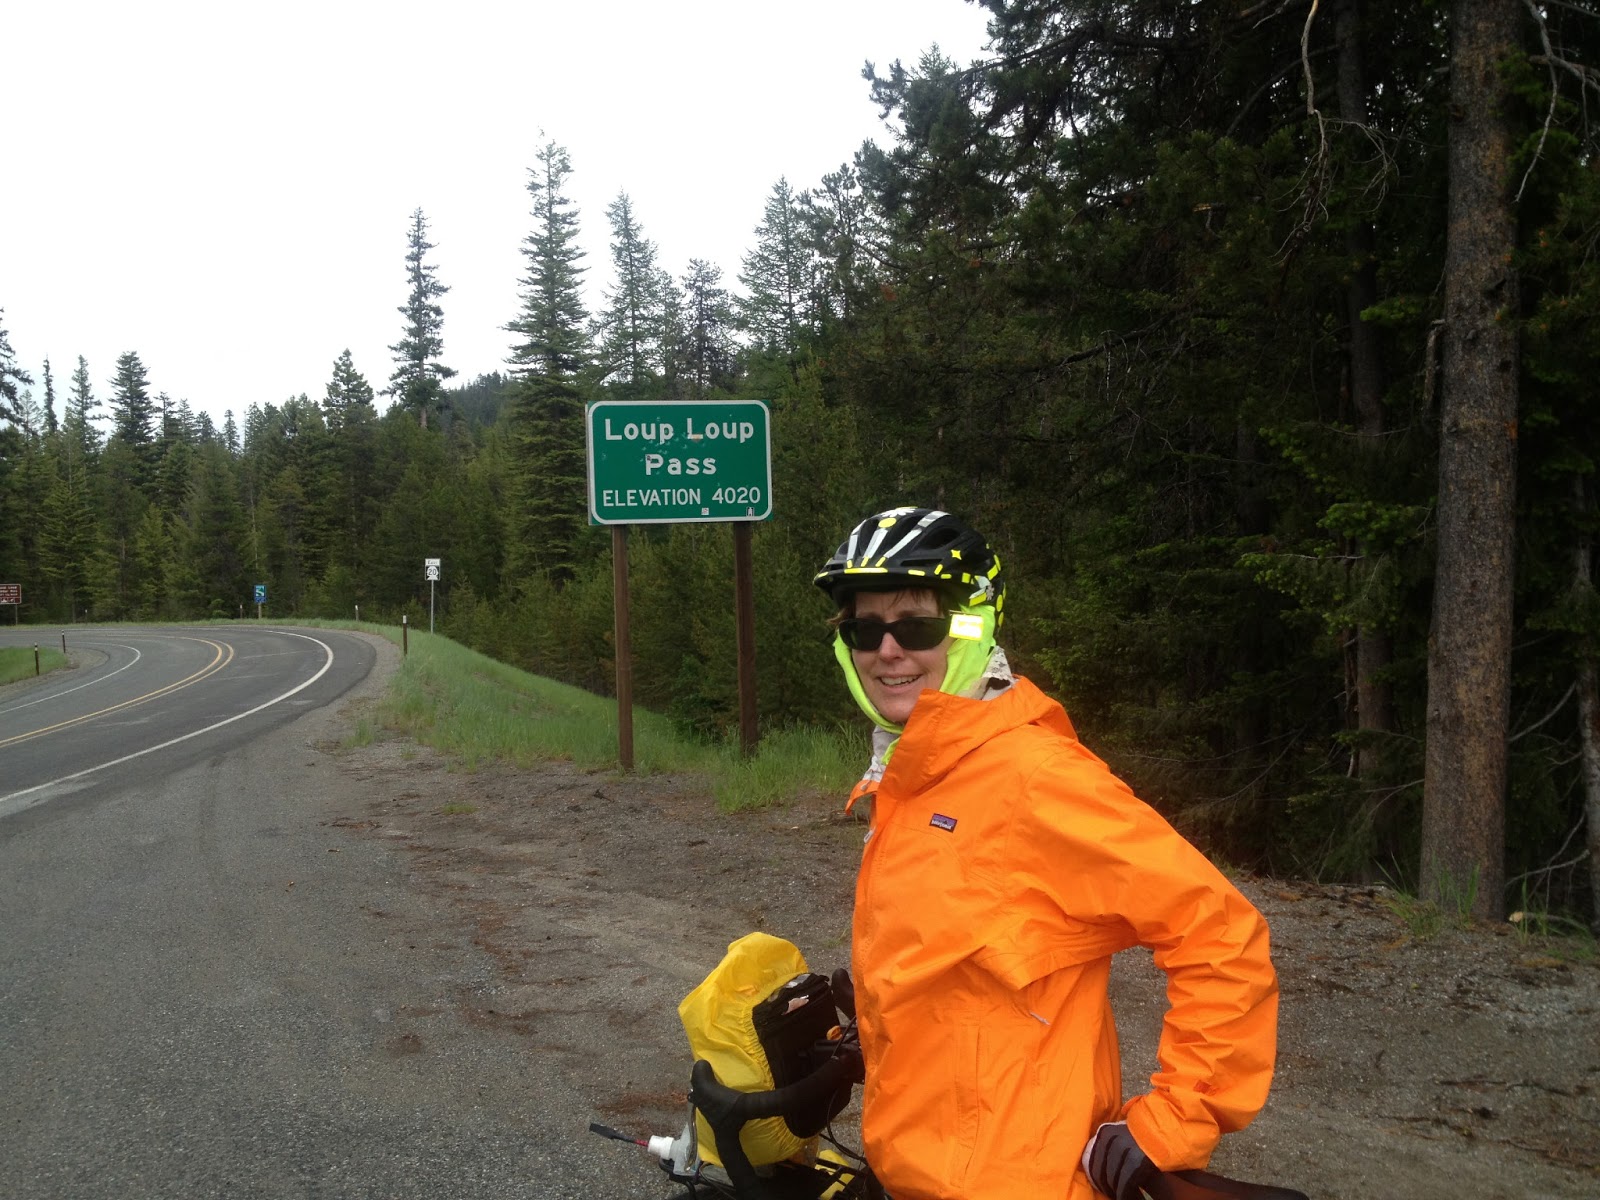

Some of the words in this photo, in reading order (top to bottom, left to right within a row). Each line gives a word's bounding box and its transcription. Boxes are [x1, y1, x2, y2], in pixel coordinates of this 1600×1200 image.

[605, 418, 674, 445] Loup
[686, 417, 754, 443] Loup
[645, 453, 717, 476] Pass
[602, 488, 701, 507] ELEVATION
[711, 486, 761, 504] 4020
[428, 568, 437, 576] 20
